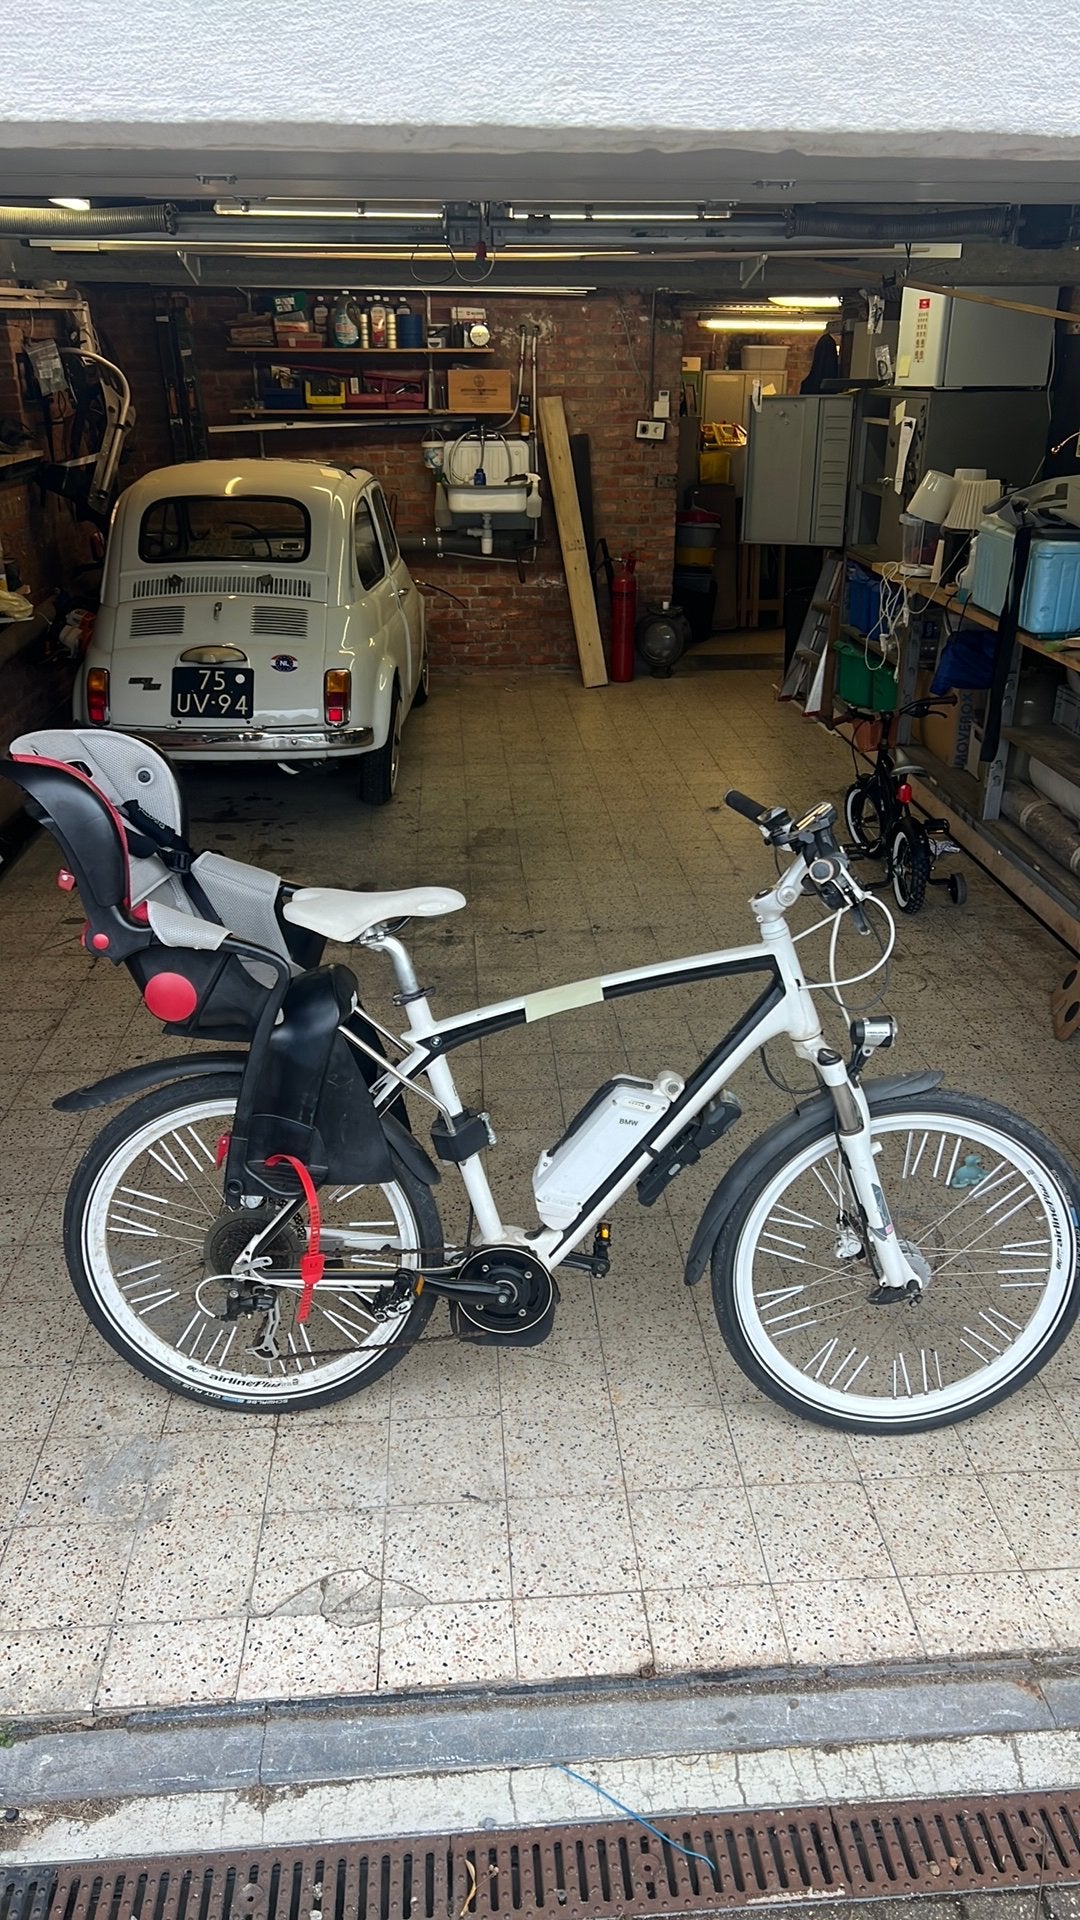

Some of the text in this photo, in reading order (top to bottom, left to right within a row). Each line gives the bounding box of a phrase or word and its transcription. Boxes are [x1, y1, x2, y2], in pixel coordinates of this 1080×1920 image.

[198, 670, 226, 691] 75
[177, 693, 248, 715] UV-94
[954, 693, 974, 769] MOVEBOX
[619, 1118, 639, 1126] BMW
[181, 1383, 203, 1394] PLUS
[204, 1391, 222, 1400] CITY
